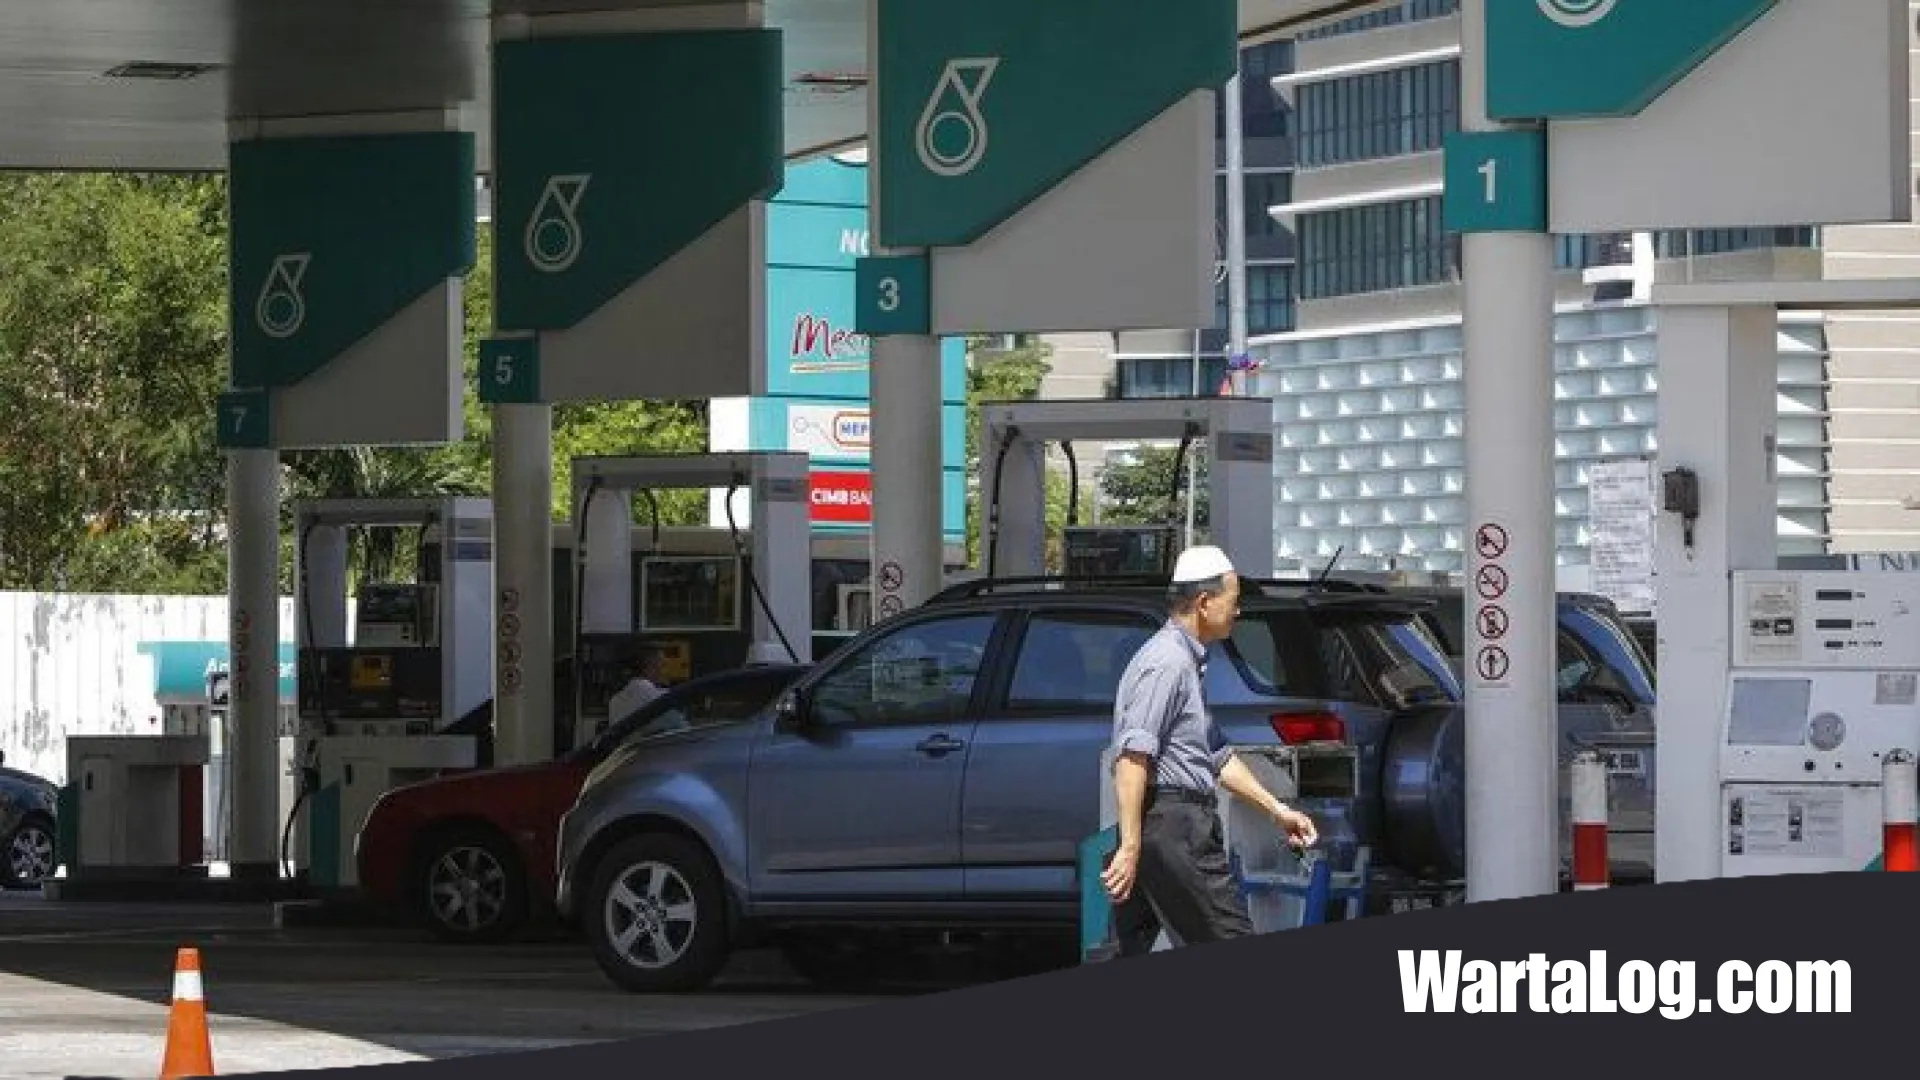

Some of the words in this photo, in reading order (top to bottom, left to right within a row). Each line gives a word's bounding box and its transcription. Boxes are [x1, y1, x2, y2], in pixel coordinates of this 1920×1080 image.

[1477, 158, 1496, 203] 1
[878, 276, 899, 311] 3
[495, 355, 513, 384] 5
[226, 407, 247, 433] 7
[811, 487, 848, 505] CIMB
